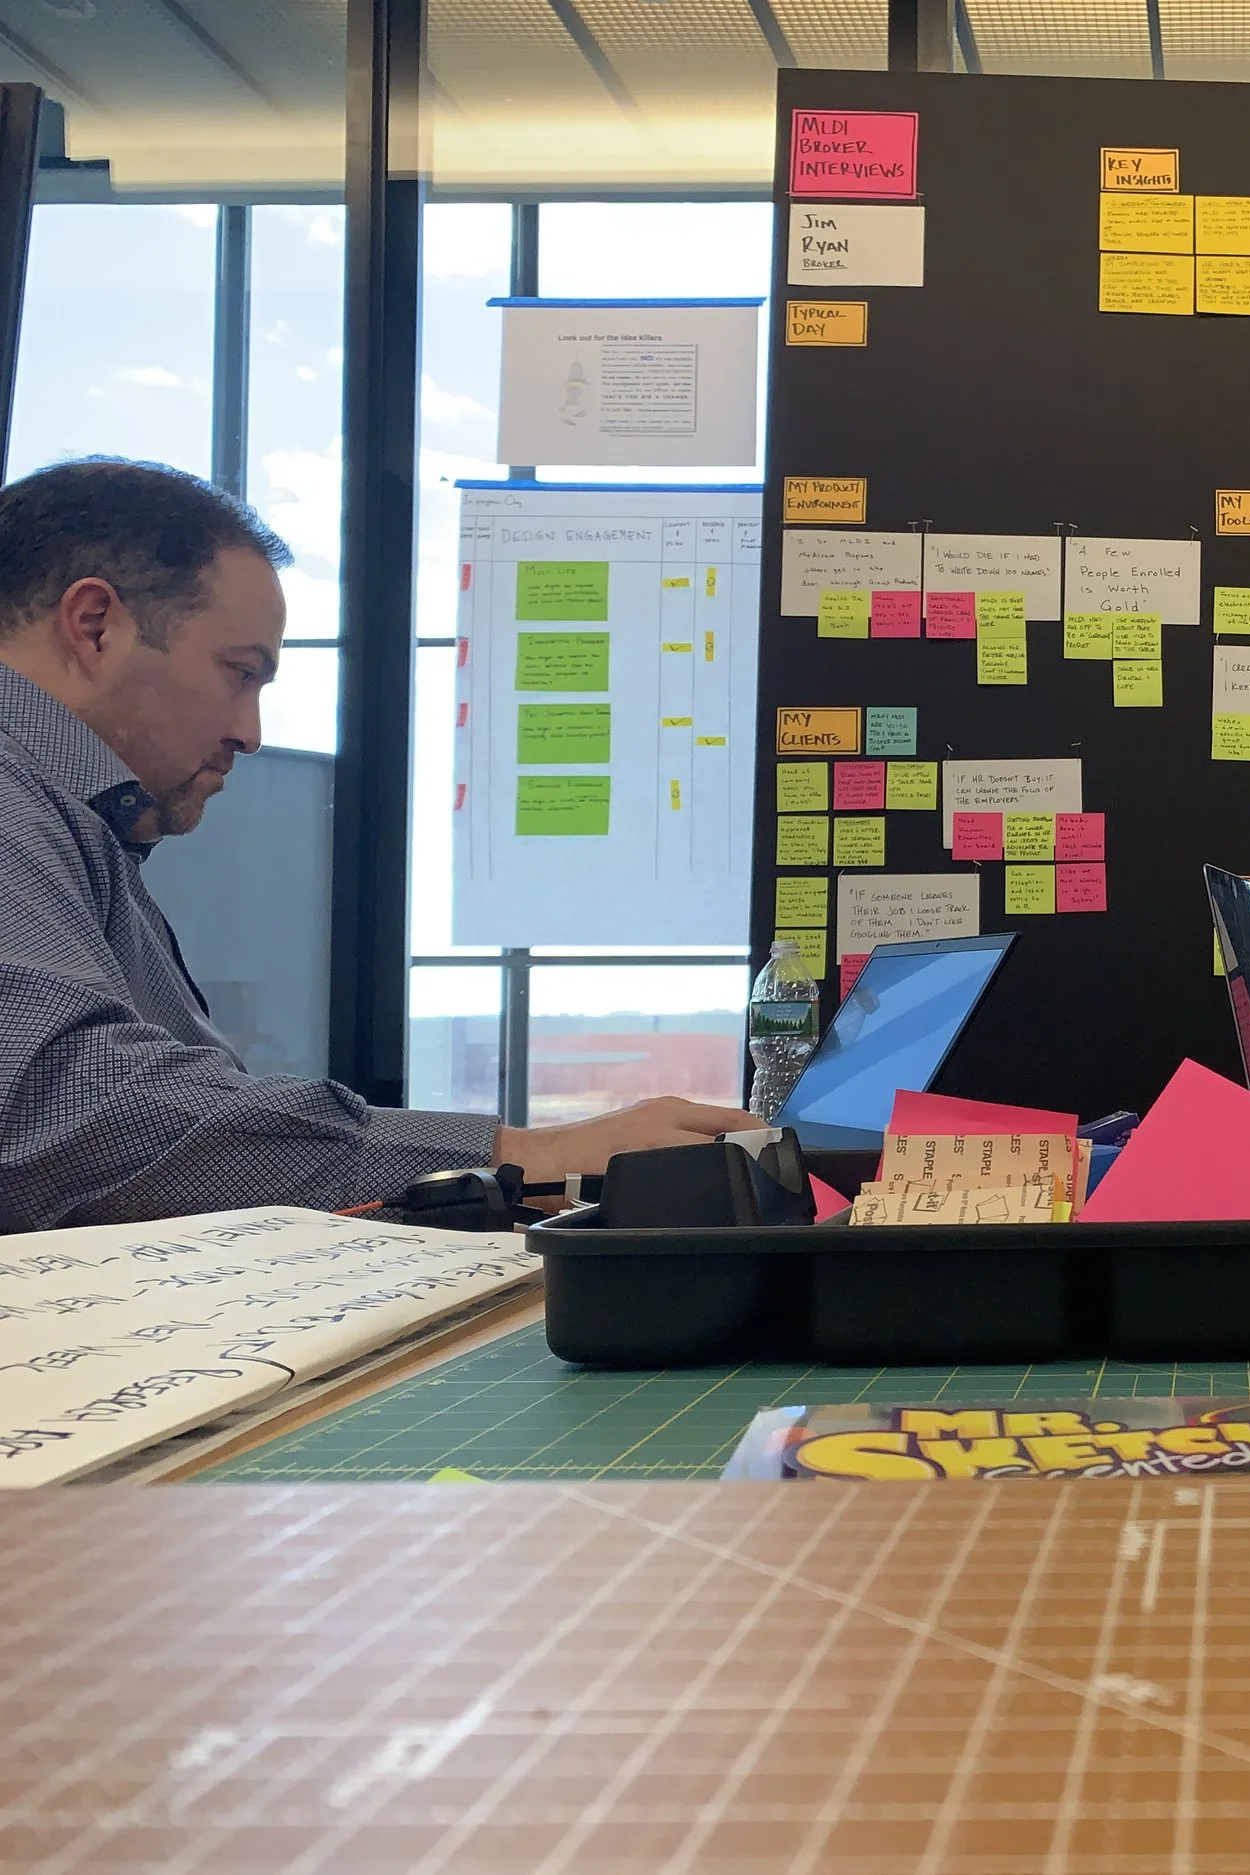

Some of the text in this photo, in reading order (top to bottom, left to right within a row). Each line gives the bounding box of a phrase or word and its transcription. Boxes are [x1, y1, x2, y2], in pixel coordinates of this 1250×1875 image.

[801, 117, 848, 136] MLDI
[800, 139, 872, 155] BROKER
[800, 162, 905, 178] INTERVIEWS
[1108, 157, 1143, 172] KEY
[1116, 173, 1172, 187] INSIGHTS
[802, 214, 837, 231] JIM
[801, 237, 849, 254] RYAN
[802, 258, 846, 269] BROKER
[792, 307, 847, 321] TYPICAL
[793, 323, 827, 337] DAY
[579, 334, 592, 342] out
[638, 334, 663, 342] killers
[788, 481, 808, 494] MY
[787, 498, 861, 510] ENVIRONMENT
[1221, 496, 1243, 509] MY
[501, 528, 555, 543] DESIGN
[566, 528, 653, 542] ENGAGEMENT
[943, 551, 1010, 560] WOULD DIE IF
[950, 566, 973, 575] WRITE
[977, 567, 1000, 576] DOWN
[1080, 566, 1182, 580] People Enrolled
[1108, 584, 1150, 594] Worth
[783, 713, 812, 728] MY
[781, 733, 841, 746] CLIENTS
[955, 797, 971, 805] THE
[871, 891, 954, 902] SOMEONE LEAVES
[851, 905, 881, 915] THEIR
[886, 907, 907, 916] JOB
[944, 903, 970, 913] TRACK
[850, 917, 963, 927] OF THEM LIKE
[850, 928, 892, 939] GOOGLING
[922, 1140, 936, 1180] STAPLE
[899, 1407, 1126, 1438] MR.
